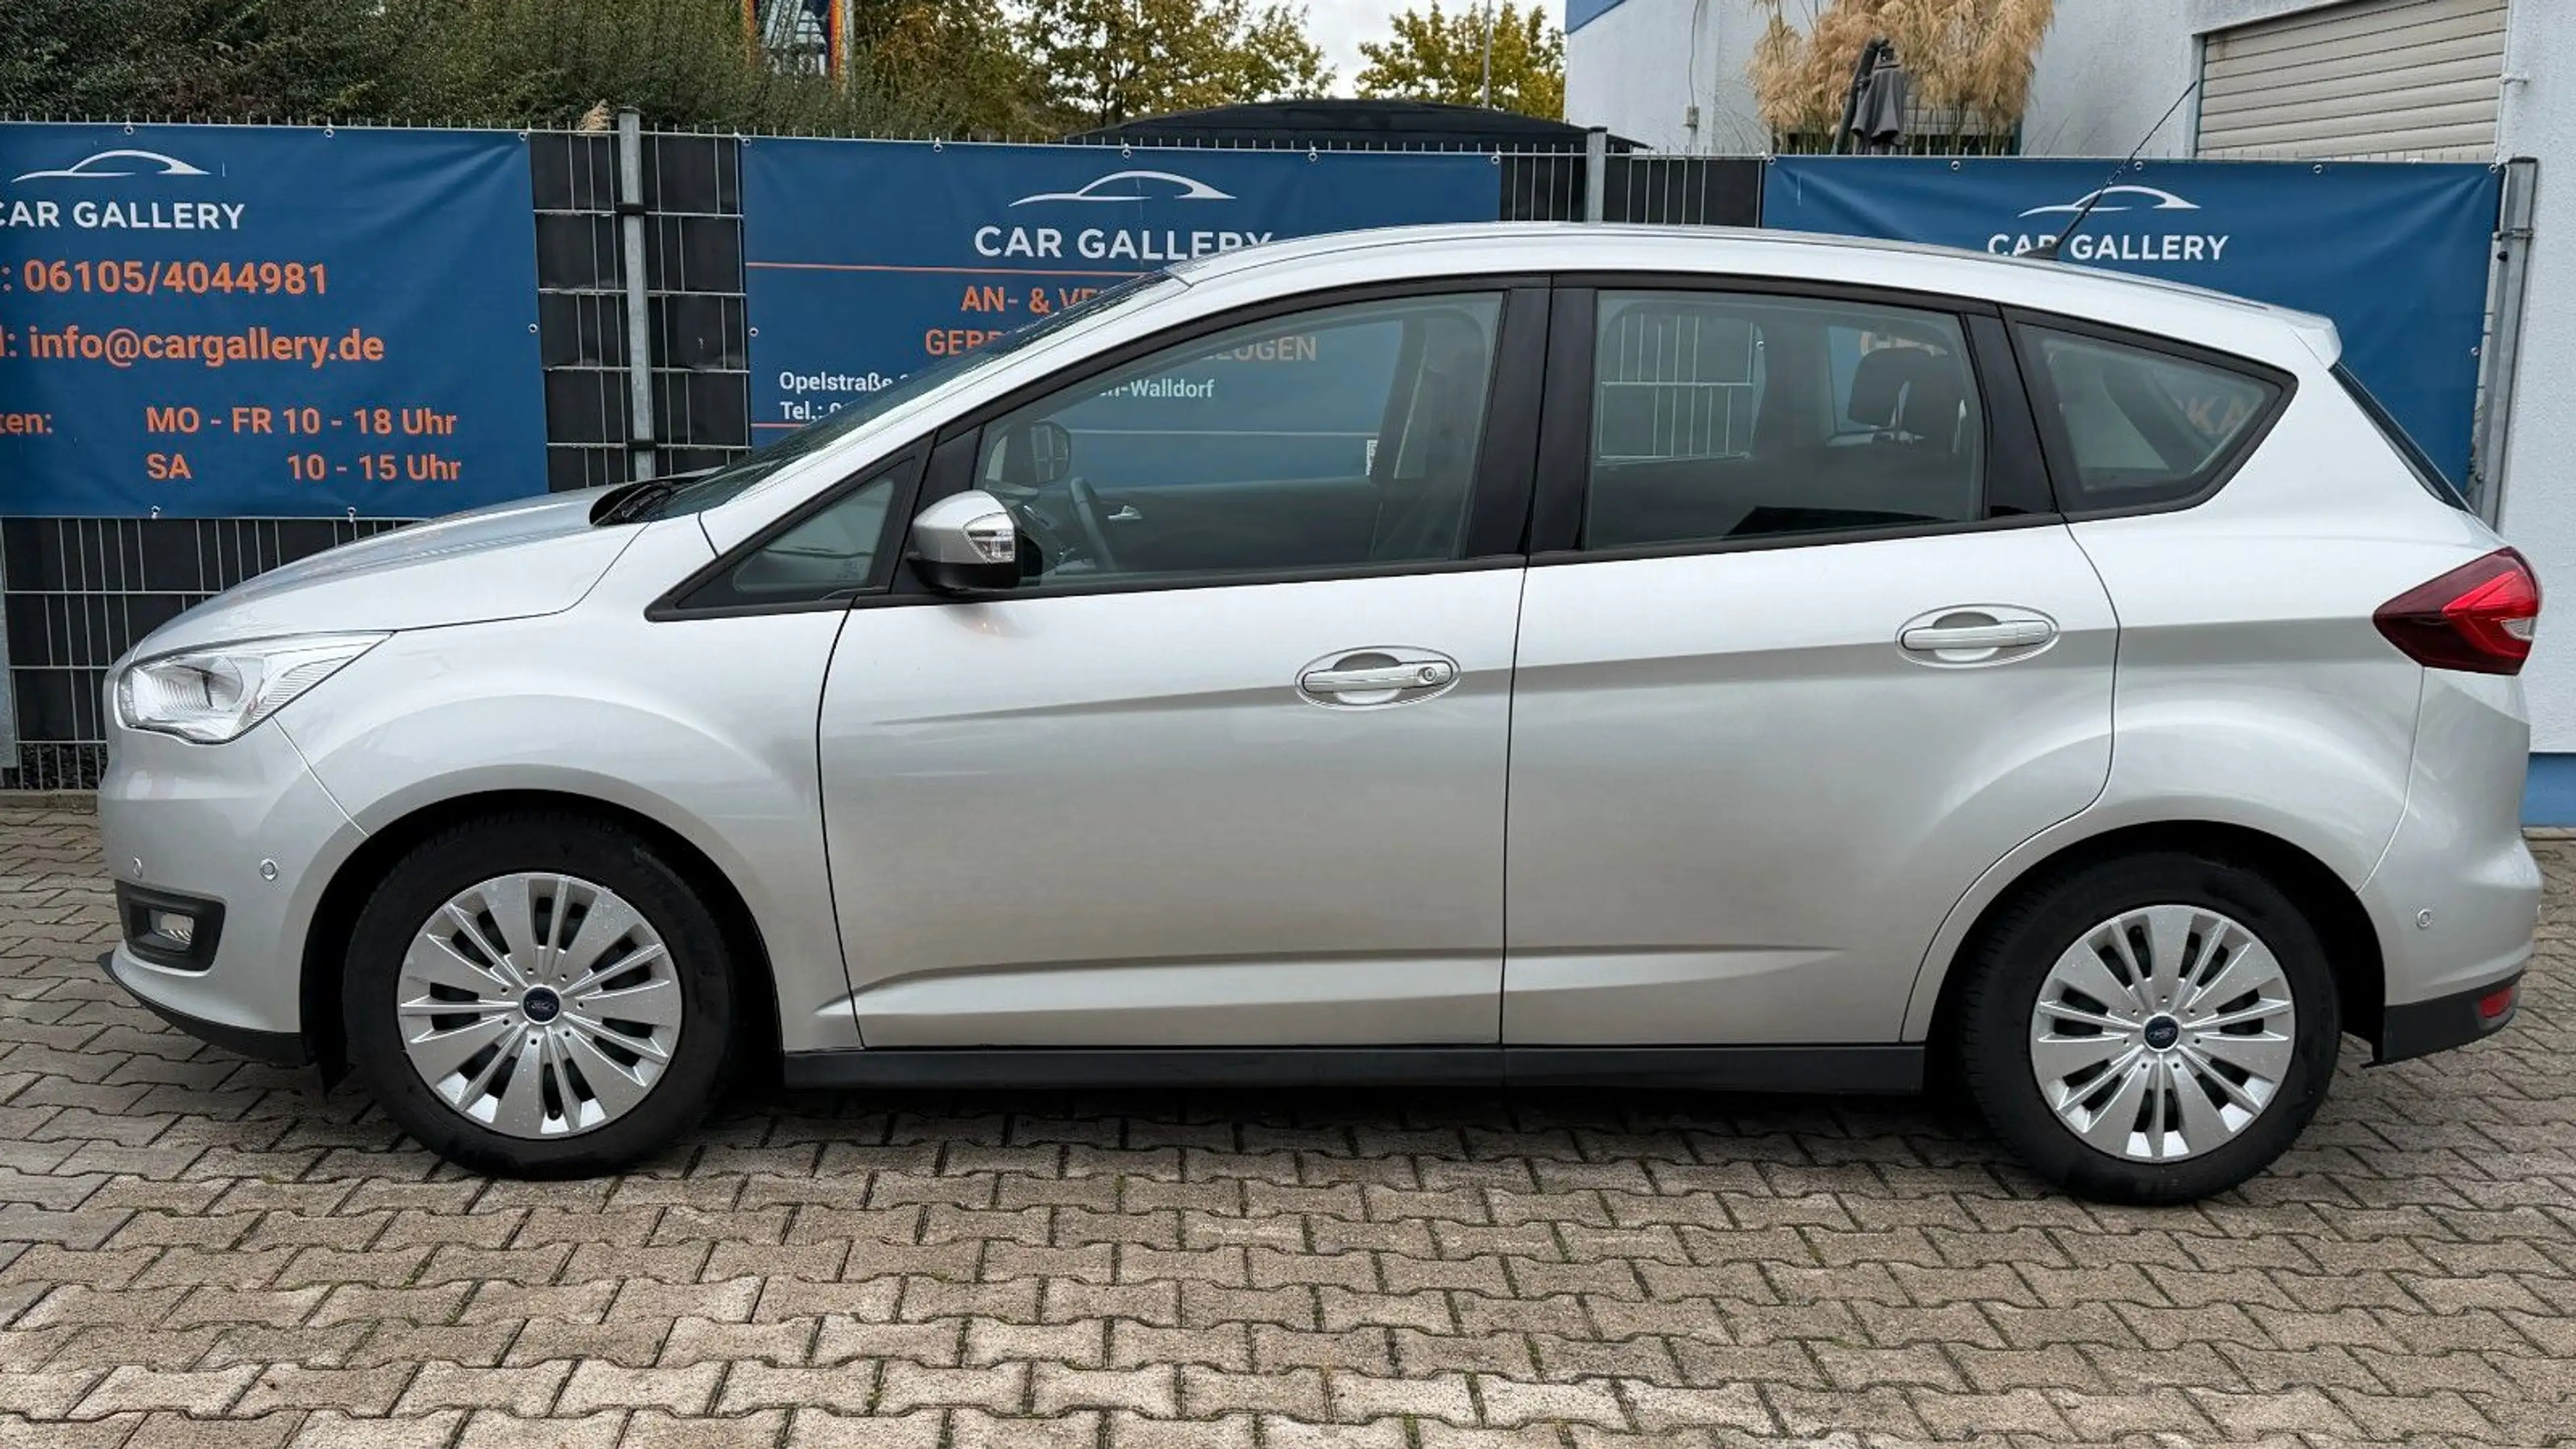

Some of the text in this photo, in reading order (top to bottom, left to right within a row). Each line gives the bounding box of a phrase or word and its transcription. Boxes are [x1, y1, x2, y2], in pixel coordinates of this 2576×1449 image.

[0, 201, 245, 229] AR GALLERY
[974, 226, 1062, 258] CAR
[2070, 234, 2229, 260] GALLERY
[23, 259, 327, 295] 06105/4044981
[961, 285, 1018, 312] AN-
[1029, 287, 1050, 314] &
[30, 324, 385, 369] info@cargallery.de
[779, 371, 893, 394] Opelstraße
[146, 406, 200, 433] MO
[231, 407, 273, 435] FR
[283, 407, 321, 435] 10
[354, 408, 392, 435] 18
[402, 407, 457, 435] Uhr
[146, 453, 193, 480] SA
[287, 453, 325, 480] 10
[359, 454, 398, 481] 15
[407, 453, 462, 481] Uhr
